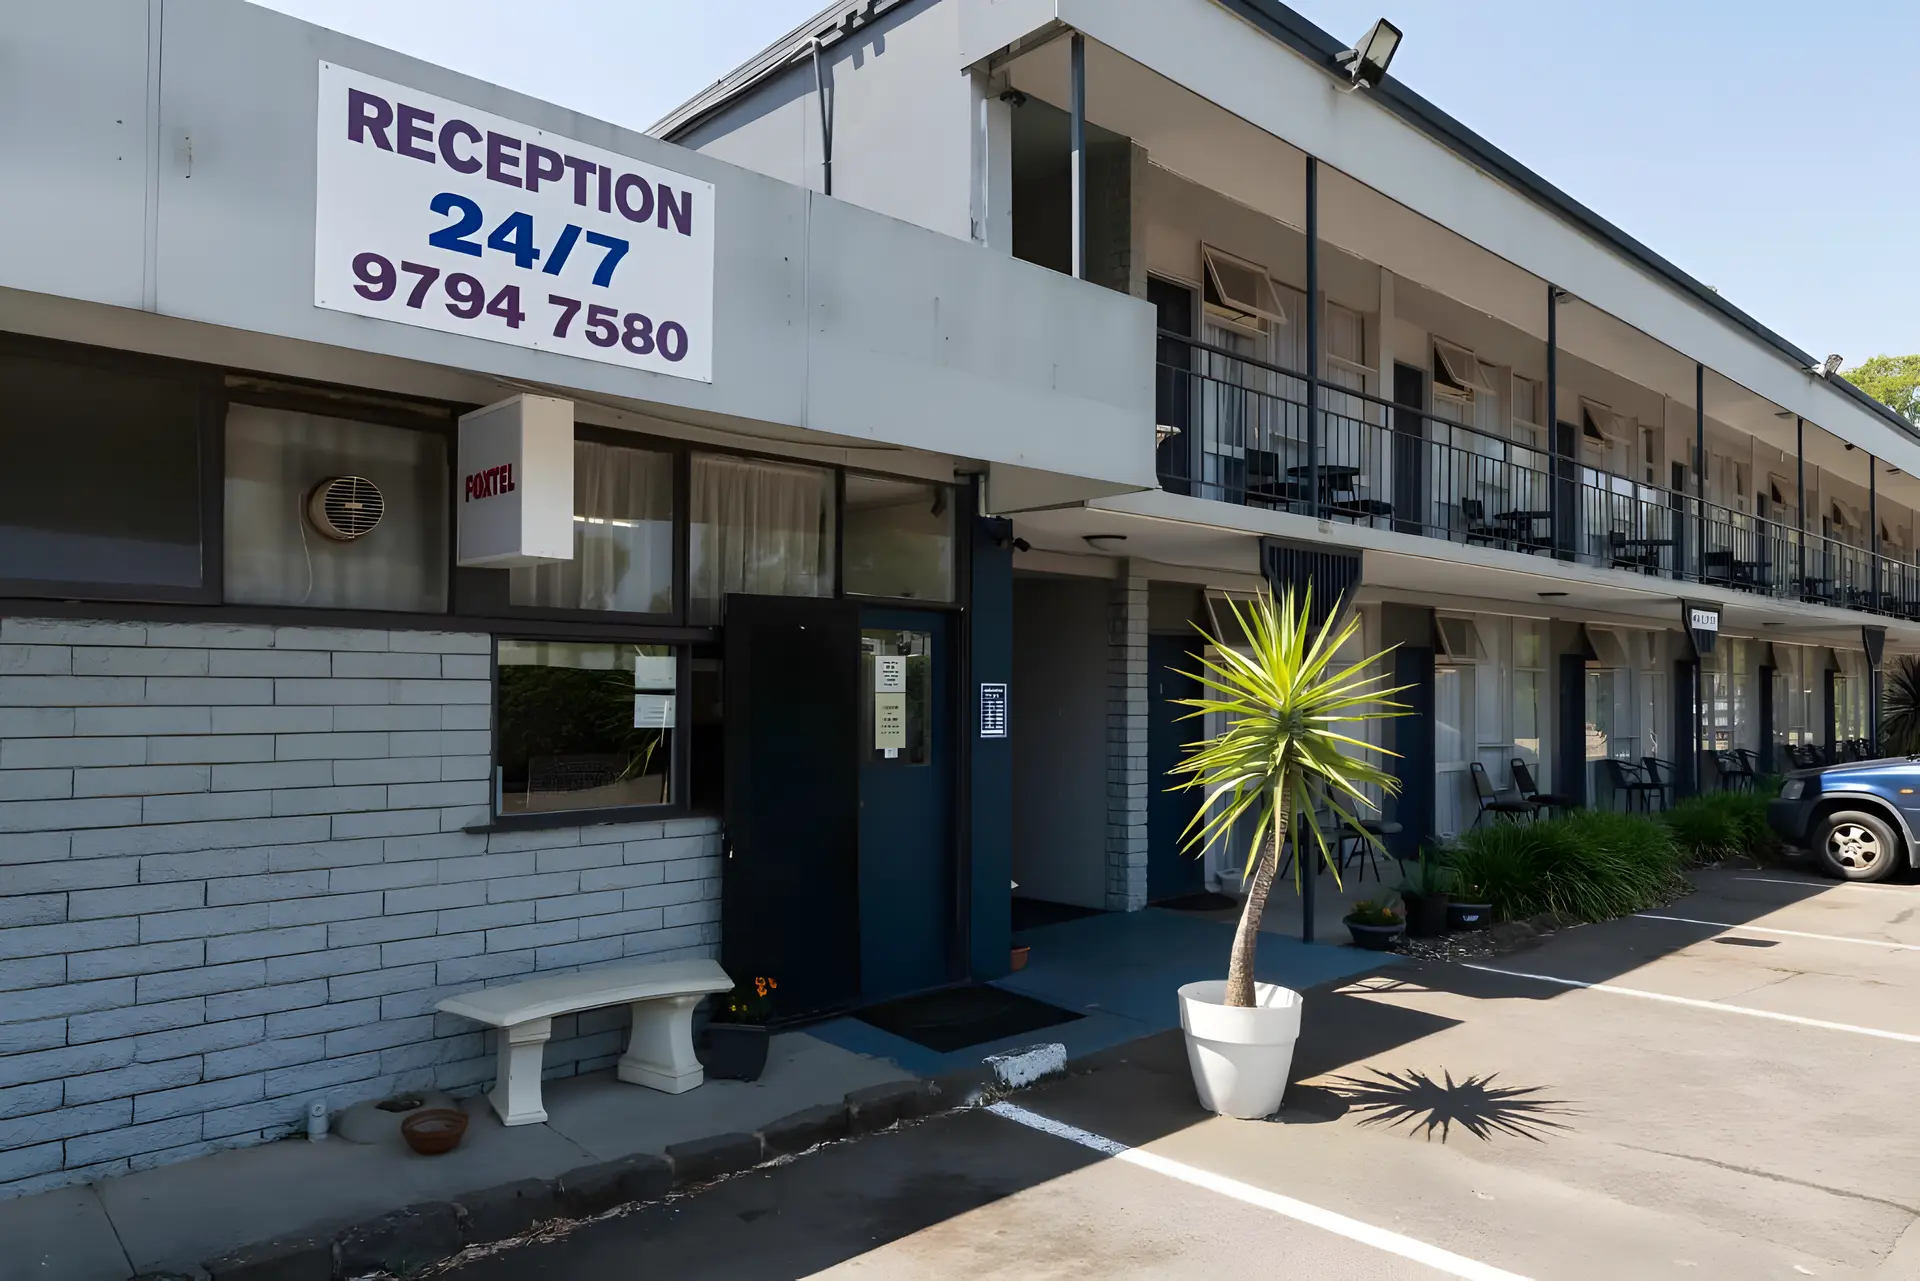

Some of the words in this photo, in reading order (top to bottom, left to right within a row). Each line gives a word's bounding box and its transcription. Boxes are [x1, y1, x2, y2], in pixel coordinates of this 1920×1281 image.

[348, 87, 692, 237] RECEPTION
[428, 192, 630, 289] 24/7
[352, 252, 525, 329] 9794
[548, 294, 688, 362] 7580
[465, 463, 515, 503] FOXTEL
